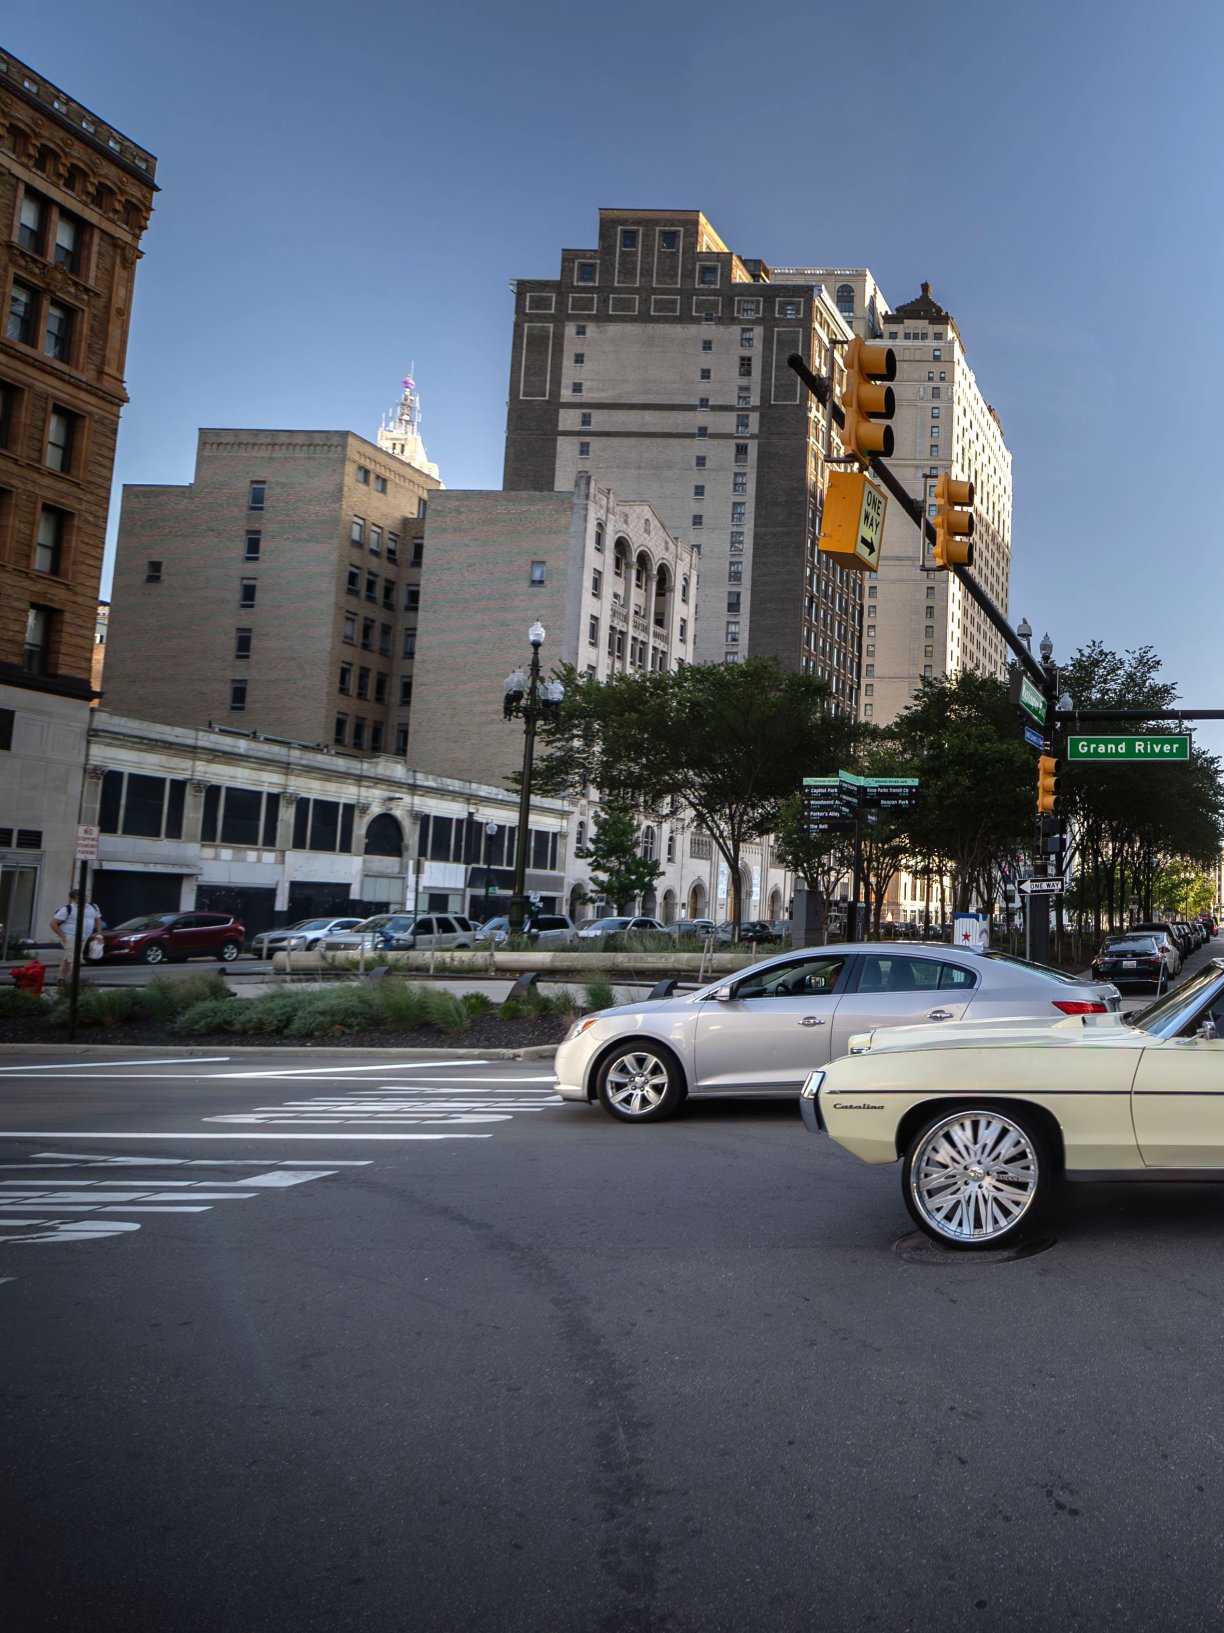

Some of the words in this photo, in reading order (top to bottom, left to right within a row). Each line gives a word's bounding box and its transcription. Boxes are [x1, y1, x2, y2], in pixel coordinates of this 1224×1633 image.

[867, 490, 882, 517] ONE
[864, 509, 880, 535] WAY
[1078, 741, 1126, 753] Grand
[1135, 741, 1179, 753] River
[833, 1102, 885, 1110] Catalina
